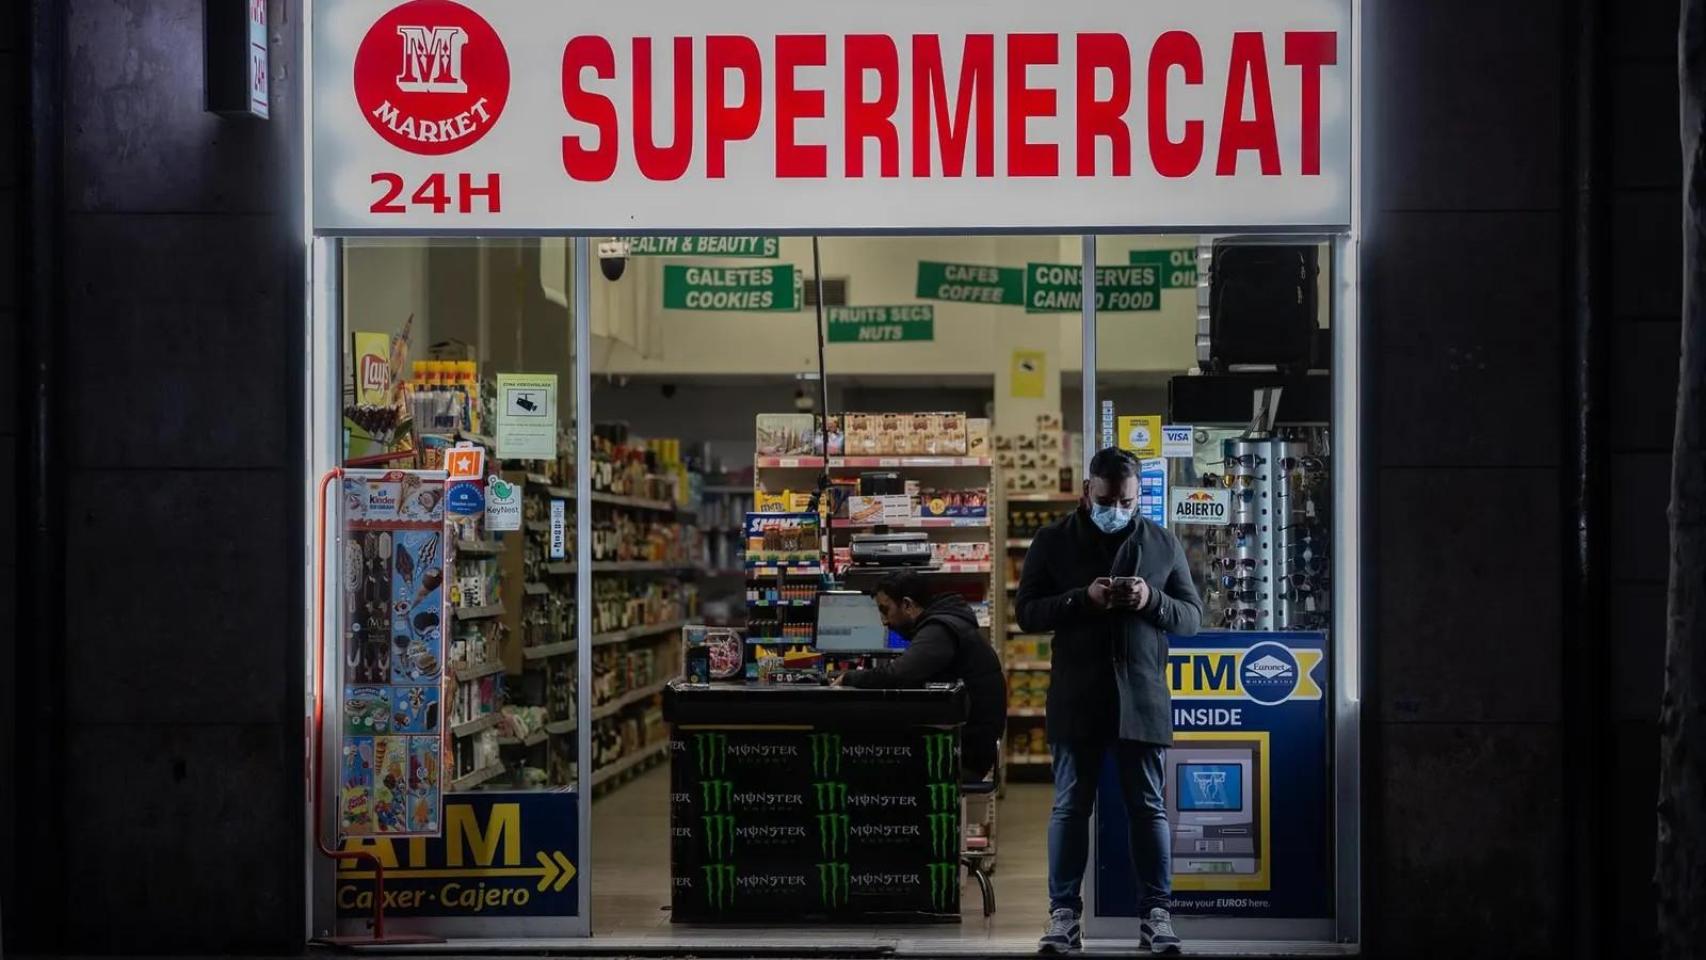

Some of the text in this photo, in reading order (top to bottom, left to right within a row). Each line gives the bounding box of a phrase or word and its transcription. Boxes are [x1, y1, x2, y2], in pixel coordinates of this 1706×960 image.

[561, 30, 1338, 182] SUPERMERCAT
[372, 97, 490, 143] MARKET
[369, 173, 501, 214] 24H
[682, 236, 695, 252] &
[697, 236, 759, 253] BEAUTY
[685, 268, 774, 287] GALETES
[945, 265, 999, 283] CAFES
[685, 291, 774, 309] COOKIES
[938, 285, 1004, 302] COFFEE
[1034, 290, 1154, 309] CANND FOOD
[829, 306, 932, 323] FRUITS SECS
[858, 325, 903, 341] NUTS
[1167, 432, 1189, 442] VISA
[487, 506, 519, 515] KeyNest
[1176, 501, 1225, 517] ABIERTO
[1167, 654, 1236, 691] TM
[1253, 662, 1286, 671] Euronet
[1174, 708, 1242, 726] INSIDE
[727, 743, 799, 756] MONSTER
[841, 744, 912, 757] MONSTER
[732, 791, 804, 804] MONSTER
[847, 792, 918, 807] MONSTER
[736, 824, 807, 838] MONSTER
[850, 823, 921, 837] MONSTER
[736, 873, 807, 887] MONSTER
[850, 872, 921, 886] MONSTER
[337, 882, 531, 912] Caxer Cajero
[1194, 900, 1215, 910] your
[1216, 898, 1248, 908] EUROS
[1248, 898, 1271, 908] here.
